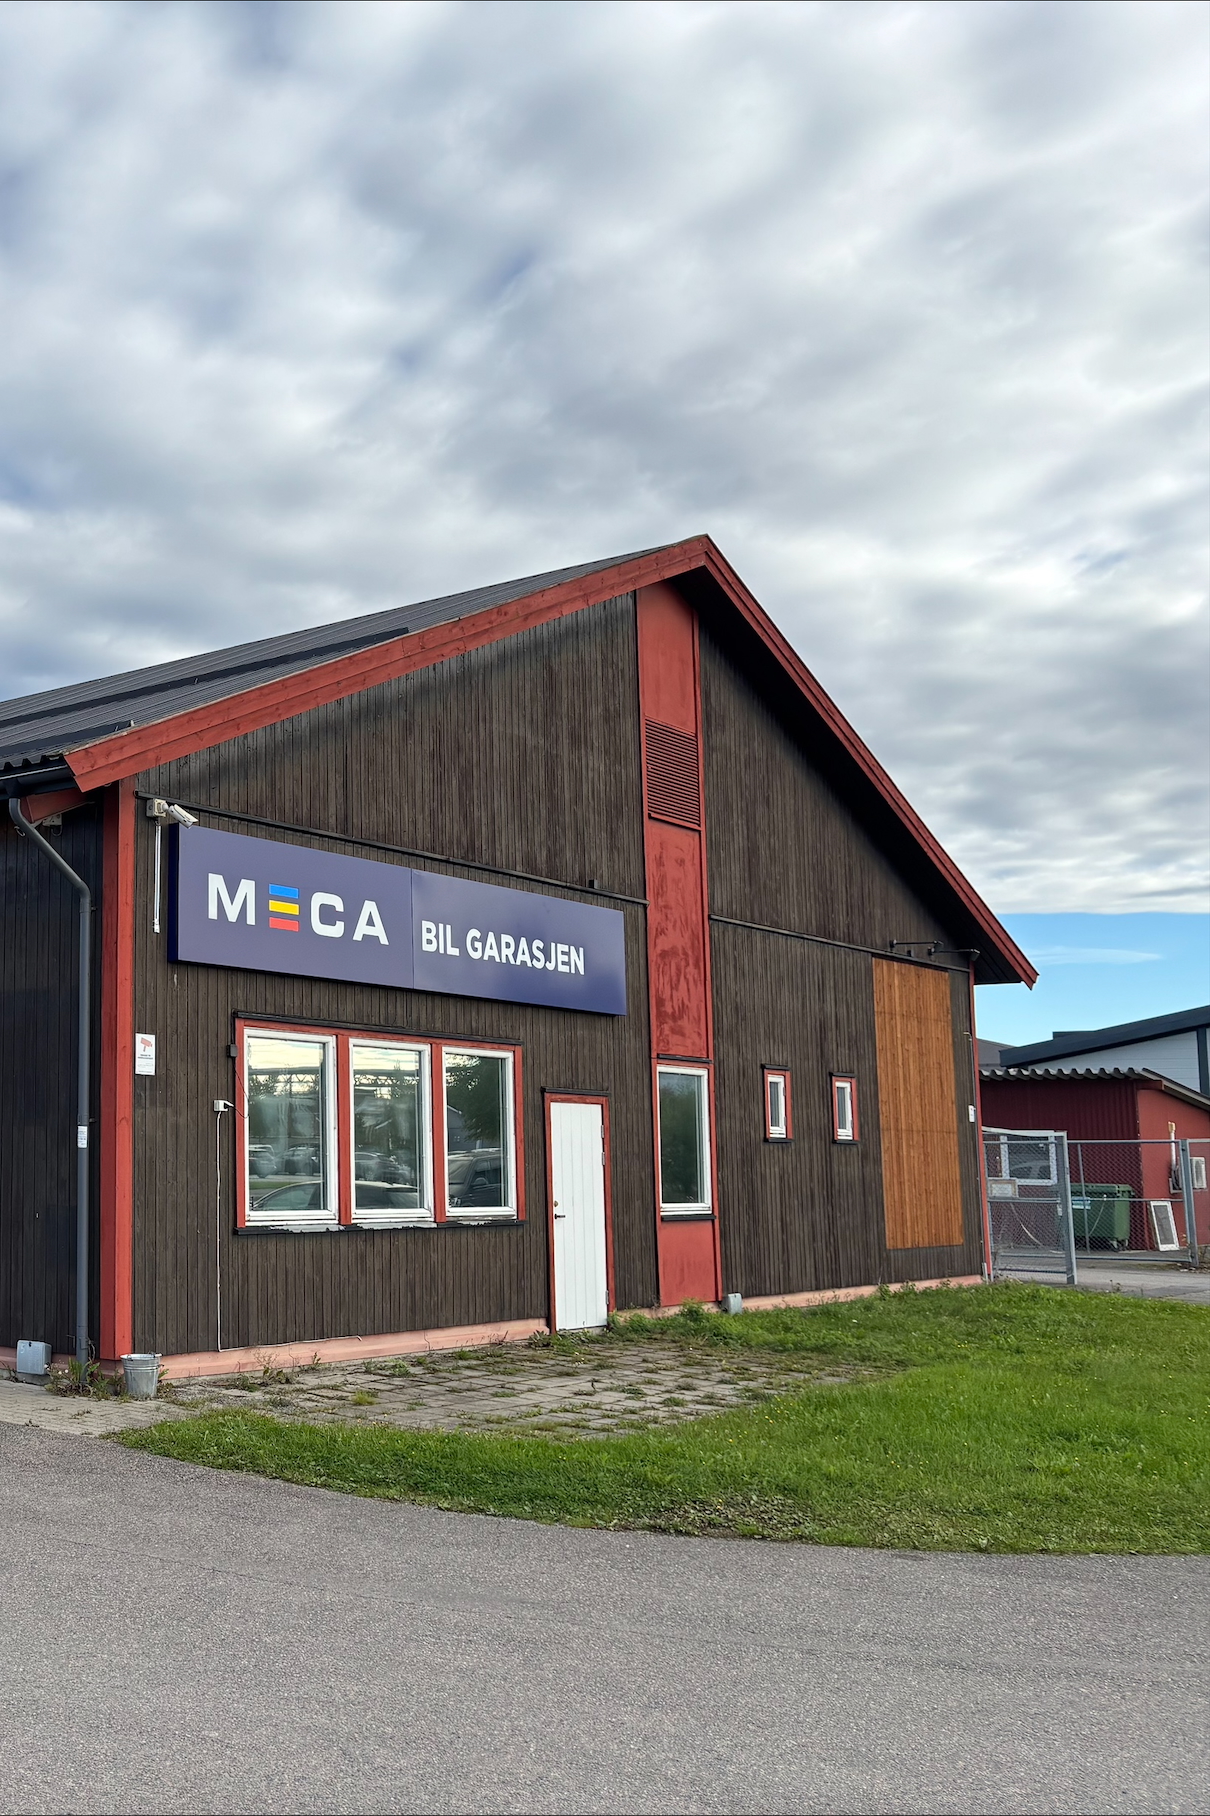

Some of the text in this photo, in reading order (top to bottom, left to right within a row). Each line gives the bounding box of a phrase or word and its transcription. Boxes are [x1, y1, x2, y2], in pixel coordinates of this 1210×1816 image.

[208, 873, 585, 975] MECA BIL GARASJEN
